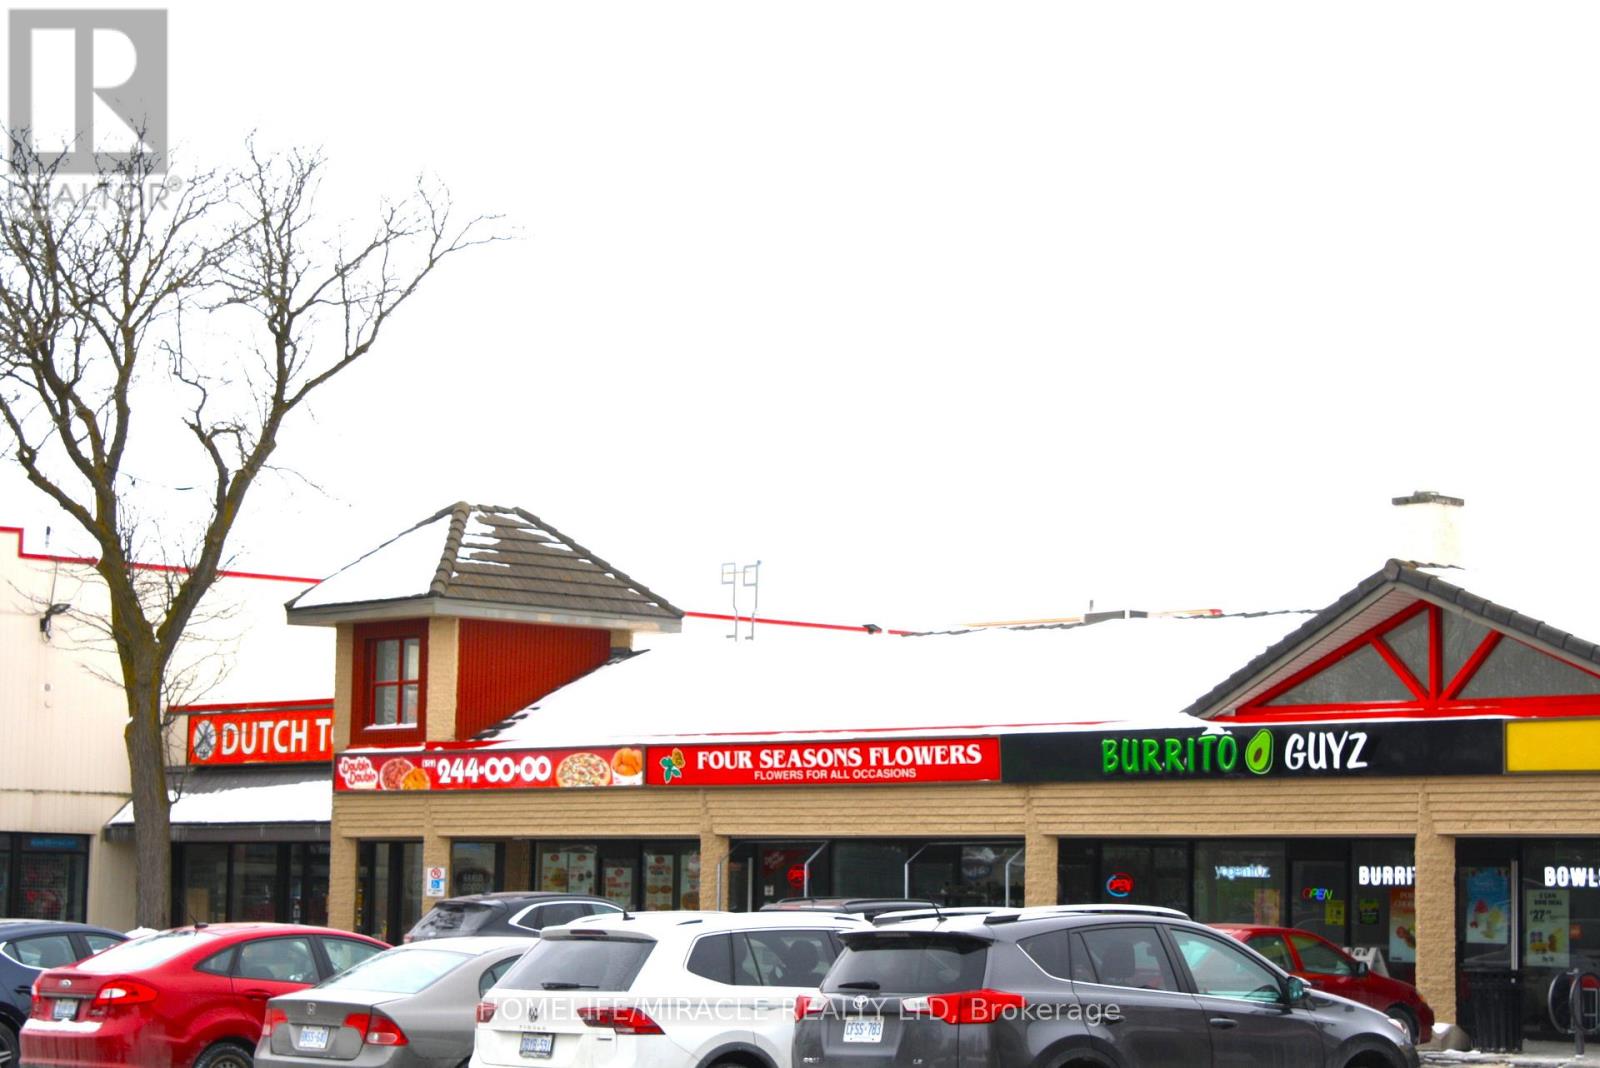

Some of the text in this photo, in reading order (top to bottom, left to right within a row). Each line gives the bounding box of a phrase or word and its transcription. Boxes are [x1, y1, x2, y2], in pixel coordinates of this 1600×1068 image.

[221, 718, 334, 756] DUTCH T
[697, 743, 983, 770] FOUR SEASONS FLOWERS
[1102, 731, 1368, 773] BURRITO GUYZ
[754, 767, 917, 781] FLOWERS FOR ALL OCCASIONS
[1358, 865, 1416, 886] BURRI
[1544, 866, 1600, 887] BOWL
[1302, 887, 1333, 901] OPEN
